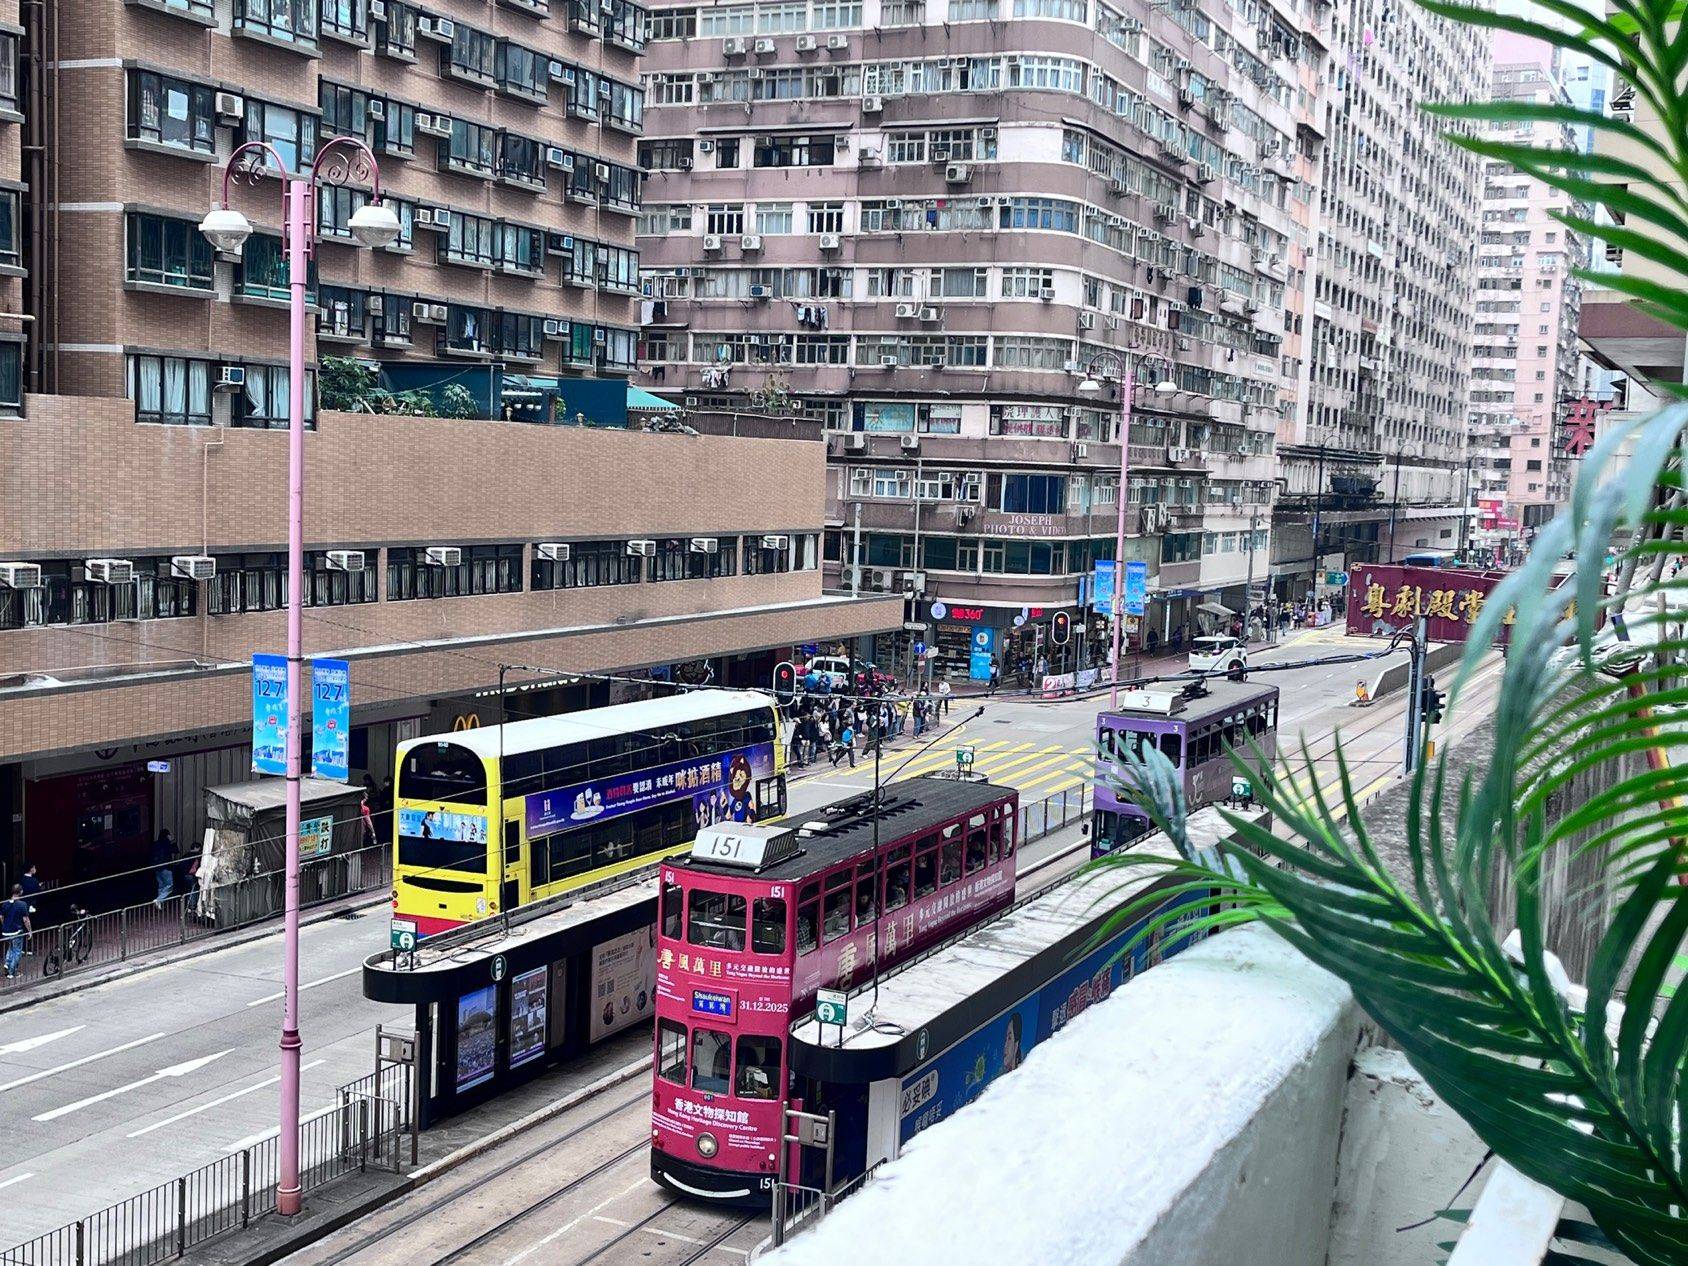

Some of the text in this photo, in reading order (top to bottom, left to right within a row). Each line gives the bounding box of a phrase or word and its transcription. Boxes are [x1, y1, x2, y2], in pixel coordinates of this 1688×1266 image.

[1009, 515, 1052, 525] JOSEPH
[984, 523, 1025, 535] PHOTO
[1029, 526, 1039, 535] &
[1142, 695, 1151, 707] 3
[1101, 718, 1106, 726] 3
[1173, 725, 1179, 733] 3
[711, 837, 742, 858] 151
[665, 870, 675, 883] 151
[771, 885, 785, 898] 151
[740, 1000, 788, 1013] 31.12.2025
[674, 1097, 754, 1124] 香港文物探知館
[691, 1115, 712, 1127] Heritage
[712, 1120, 738, 1131] Discovery
[760, 1177, 775, 1189] 151
